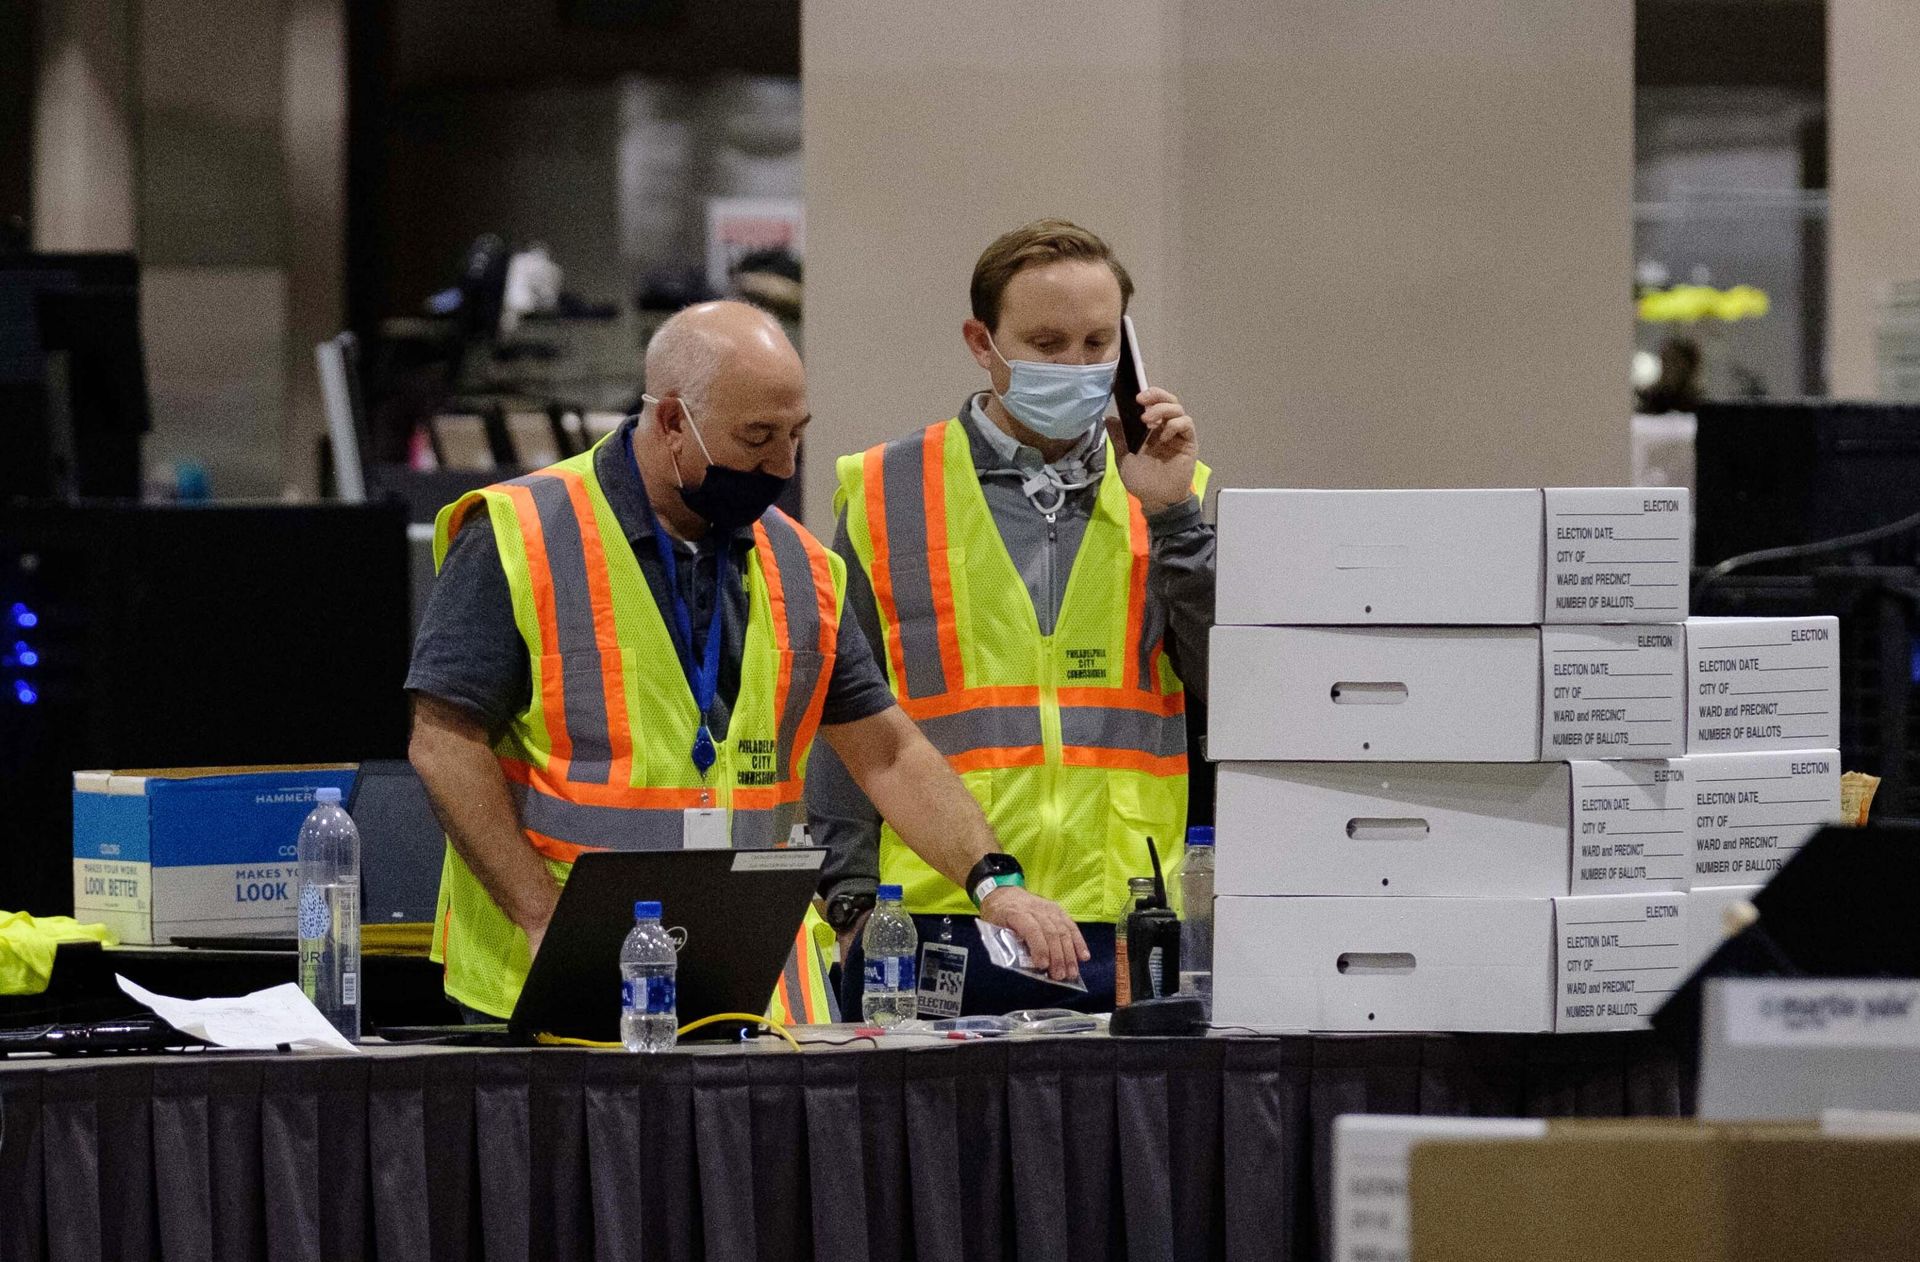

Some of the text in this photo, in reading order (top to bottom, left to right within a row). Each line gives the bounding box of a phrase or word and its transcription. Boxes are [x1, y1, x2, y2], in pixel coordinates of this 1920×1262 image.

[1644, 501, 1678, 511] ELECTION
[1557, 528, 1613, 539] ELECTION DATE
[1557, 551, 1585, 562] CITY OF
[1557, 574, 1630, 585] WARD and PRECINCT
[1556, 596, 1634, 608] NUMBER OF BALLOTS
[1792, 629, 1828, 641] ELECTION
[1638, 636, 1672, 647] ELECTION
[1078, 659, 1095, 668] CITY
[1554, 664, 1608, 675] ELECTION DATE
[1700, 659, 1759, 672] ELECTION DATE
[1554, 687, 1581, 698] CITY OF
[1700, 683, 1729, 695] CITY OF
[1554, 709, 1625, 721] WARD and PRECINCT
[1699, 704, 1778, 717] WARD and PRECINCT
[1553, 732, 1628, 745] NUMBER OF BALLOTS
[1699, 726, 1781, 740] NUMBER OF BALLOTS
[752, 755, 771, 769] CITY
[1792, 763, 1829, 774] ELECTION
[1655, 770, 1684, 781] ELECTION
[1697, 792, 1758, 805] ELECTION DATE
[1582, 799, 1629, 811] ELECTION DATE
[1582, 822, 1606, 834] CITY OF
[1697, 816, 1728, 828] CITY OF
[1697, 837, 1778, 850] WARD and PRECINCT
[1582, 844, 1644, 856] WARD and PRECINCT
[1696, 859, 1782, 873] NUMBER OF BALLOTS
[236, 869, 281, 879] MAKES
[1581, 867, 1646, 880] NUMBER OF BALLOTS
[85, 877, 138, 898] LOOK BETTER
[236, 882, 288, 902] LOOK
[1647, 906, 1678, 918] ELECTION
[1567, 935, 1618, 948] ELECTION DATE
[1567, 960, 1593, 971] CITY OF
[1567, 981, 1635, 994] WARD and PRECINCT
[1566, 1004, 1637, 1017] NUMBER OF BALLOTS
